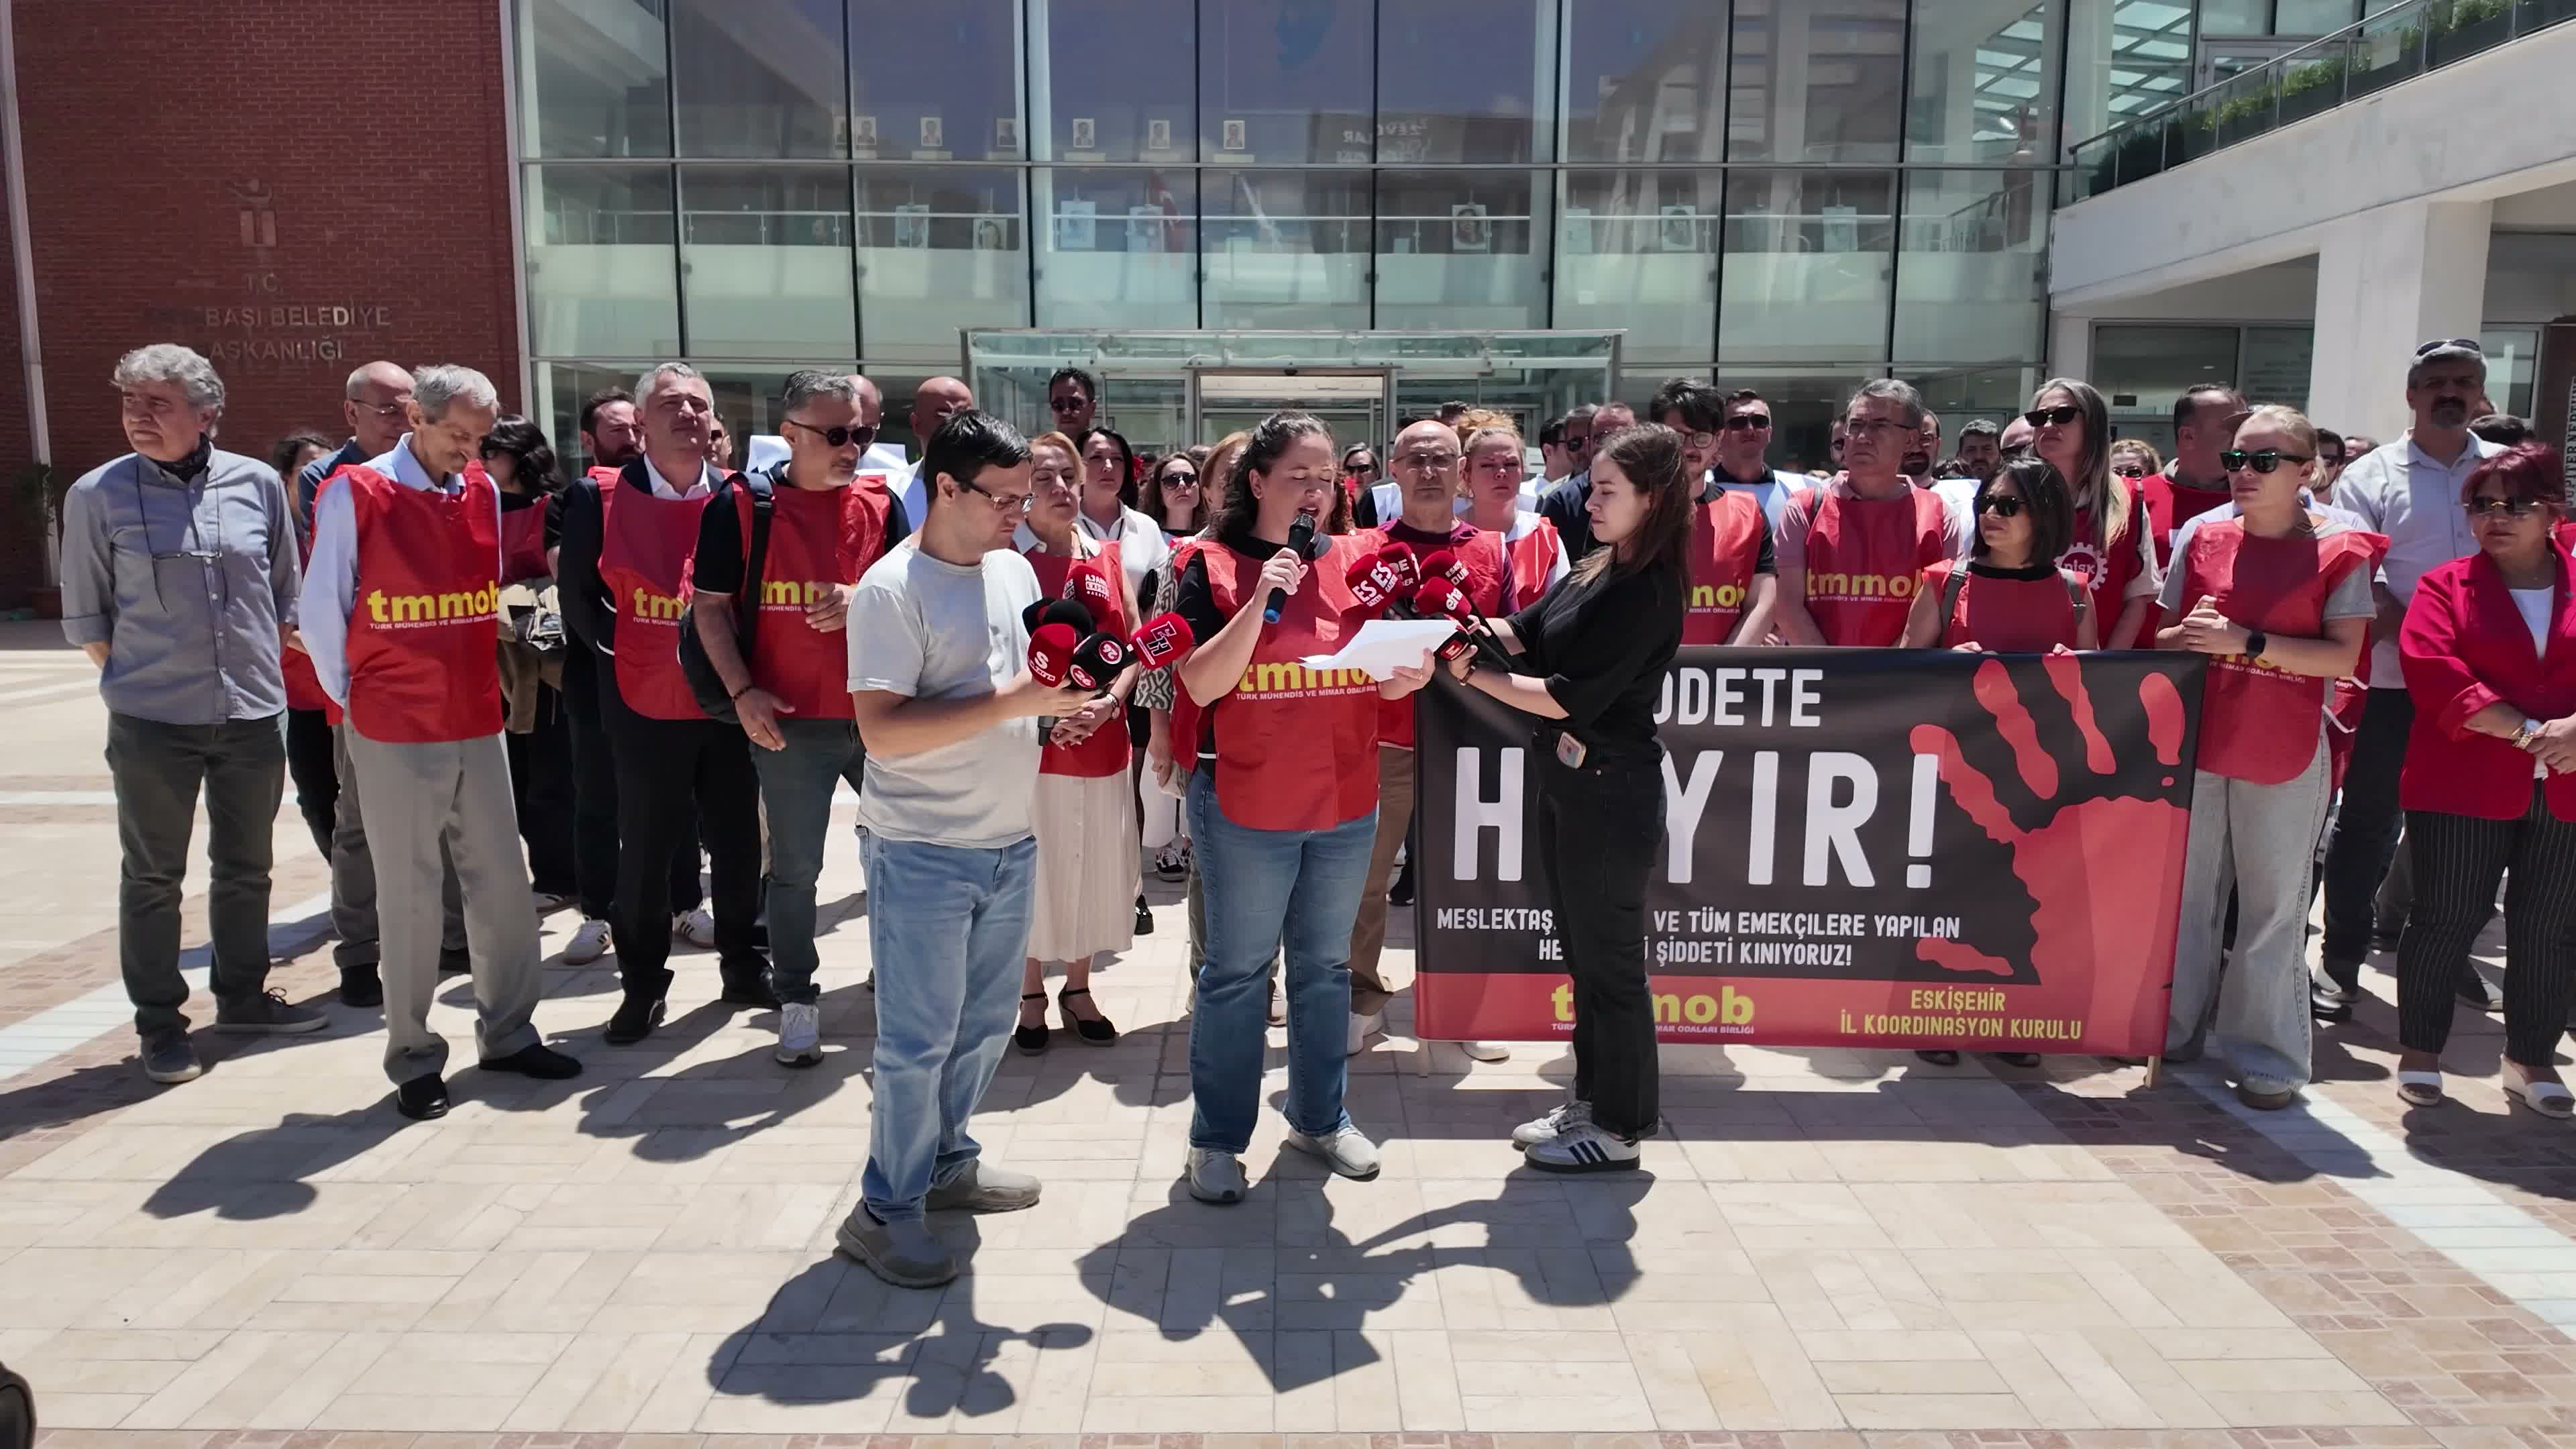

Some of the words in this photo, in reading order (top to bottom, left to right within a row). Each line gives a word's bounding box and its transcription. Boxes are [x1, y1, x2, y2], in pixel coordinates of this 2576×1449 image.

[271, 302, 391, 327] BELEDİYE
[209, 335, 343, 361] AŞKANLIĞI
[1370, 561, 1392, 588] ES
[1352, 580, 1377, 602] ES
[1236, 692, 1258, 700] TÜRK
[1260, 690, 1304, 700] MÜHENDİS
[1319, 688, 1346, 696] MİMAR
[1454, 747, 1938, 889] HYIR!
[1437, 908, 1555, 935] MESLEKTAŞ
[1654, 911, 1679, 933] VE
[1688, 906, 1730, 934] TÜM
[1874, 914, 1960, 938] YAPILAN
[1539, 939, 1564, 961] HE
[1656, 935, 1733, 967] ŞİDDETİ
[1739, 941, 1853, 967] KINIYORUZ!
[1911, 986, 2006, 1014] ESKİŞEHİR
[1655, 1024, 1675, 1033] MAR
[1677, 1025, 1718, 1034] ODALARI
[1841, 1008, 1857, 1034] İL
[2010, 1019, 2082, 1040] KURULU
